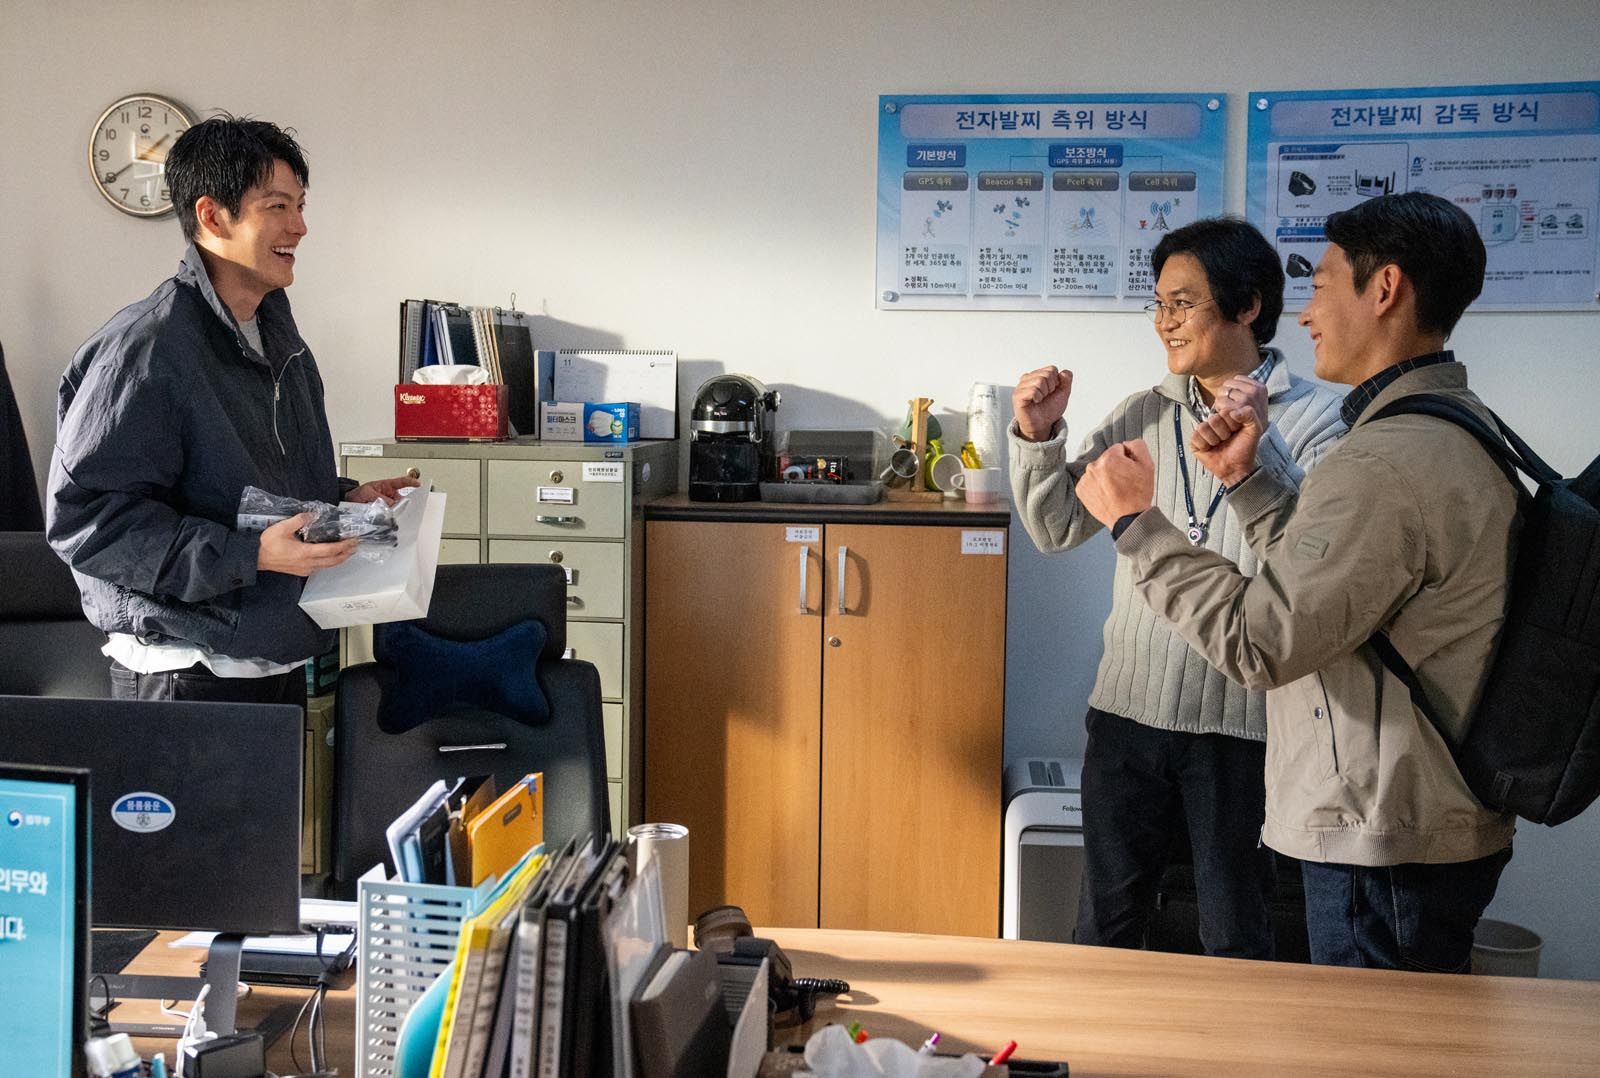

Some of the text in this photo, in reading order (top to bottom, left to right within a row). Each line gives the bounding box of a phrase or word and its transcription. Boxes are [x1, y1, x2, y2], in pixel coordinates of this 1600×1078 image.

[121, 112, 129, 124] 11
[138, 107, 152, 118] 12
[1331, 101, 1539, 127] 전자발찌 감독 방식
[164, 113, 168, 124] 1
[956, 110, 1147, 130] 전자발찌 측위 방식
[106, 129, 116, 140] 10
[99, 150, 110, 161] 9
[916, 151, 956, 161] 기본방식
[1065, 147, 1107, 158] 보조방식
[105, 172, 116, 183] 8
[120, 189, 130, 200] 7
[161, 190, 171, 200] 5
[140, 195, 150, 206] 6
